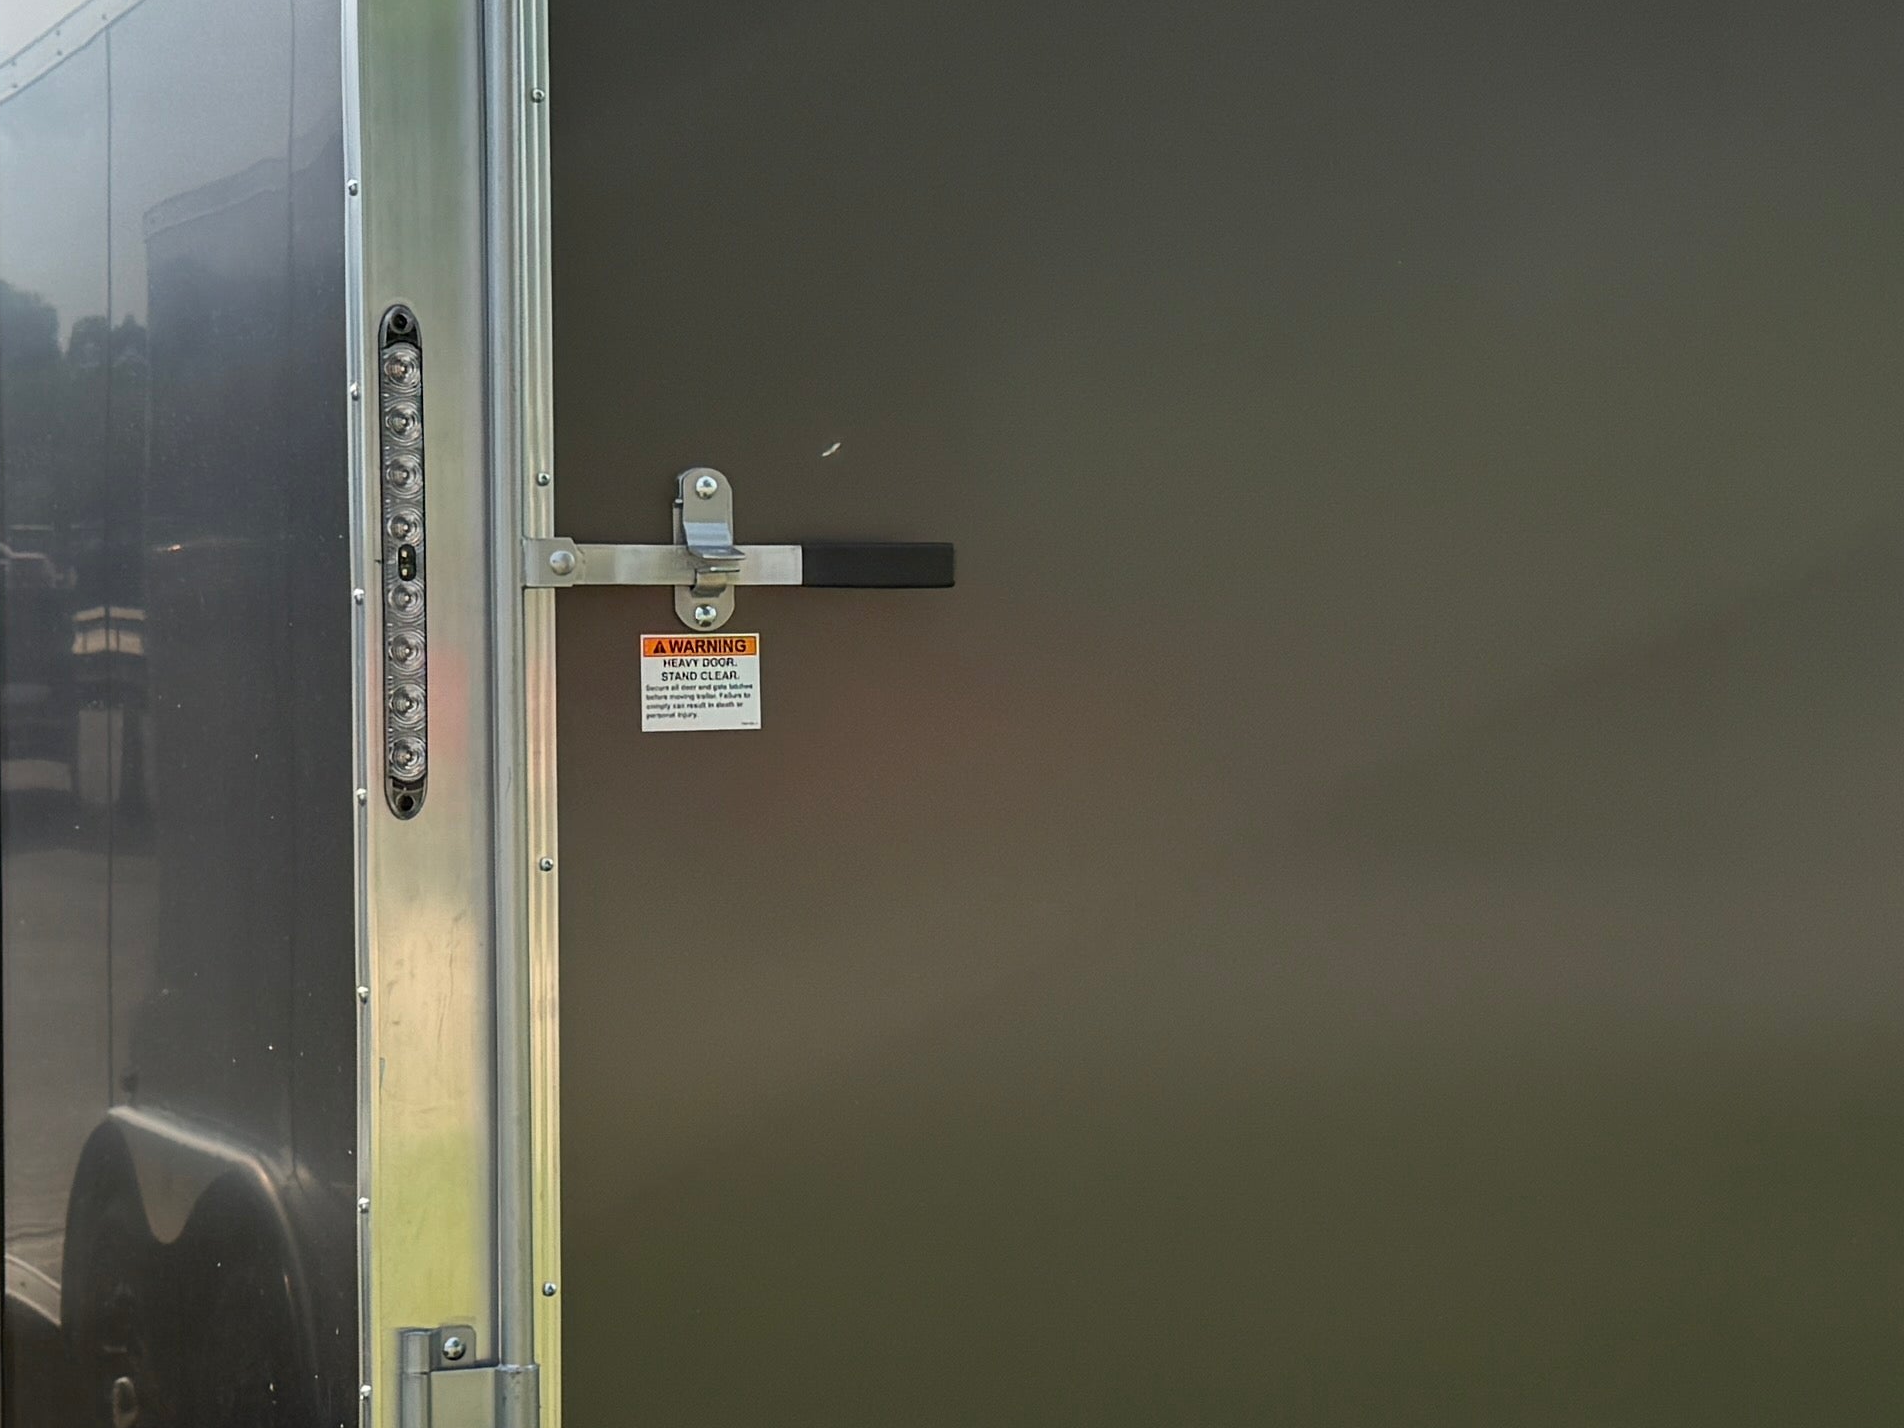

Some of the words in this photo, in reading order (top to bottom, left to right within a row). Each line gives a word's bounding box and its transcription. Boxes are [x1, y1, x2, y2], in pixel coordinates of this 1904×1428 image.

[669, 639, 747, 654] WARNING
[663, 658, 699, 668] HEAVY
[702, 657, 738, 668] DOOR.
[661, 671, 697, 682] STAND
